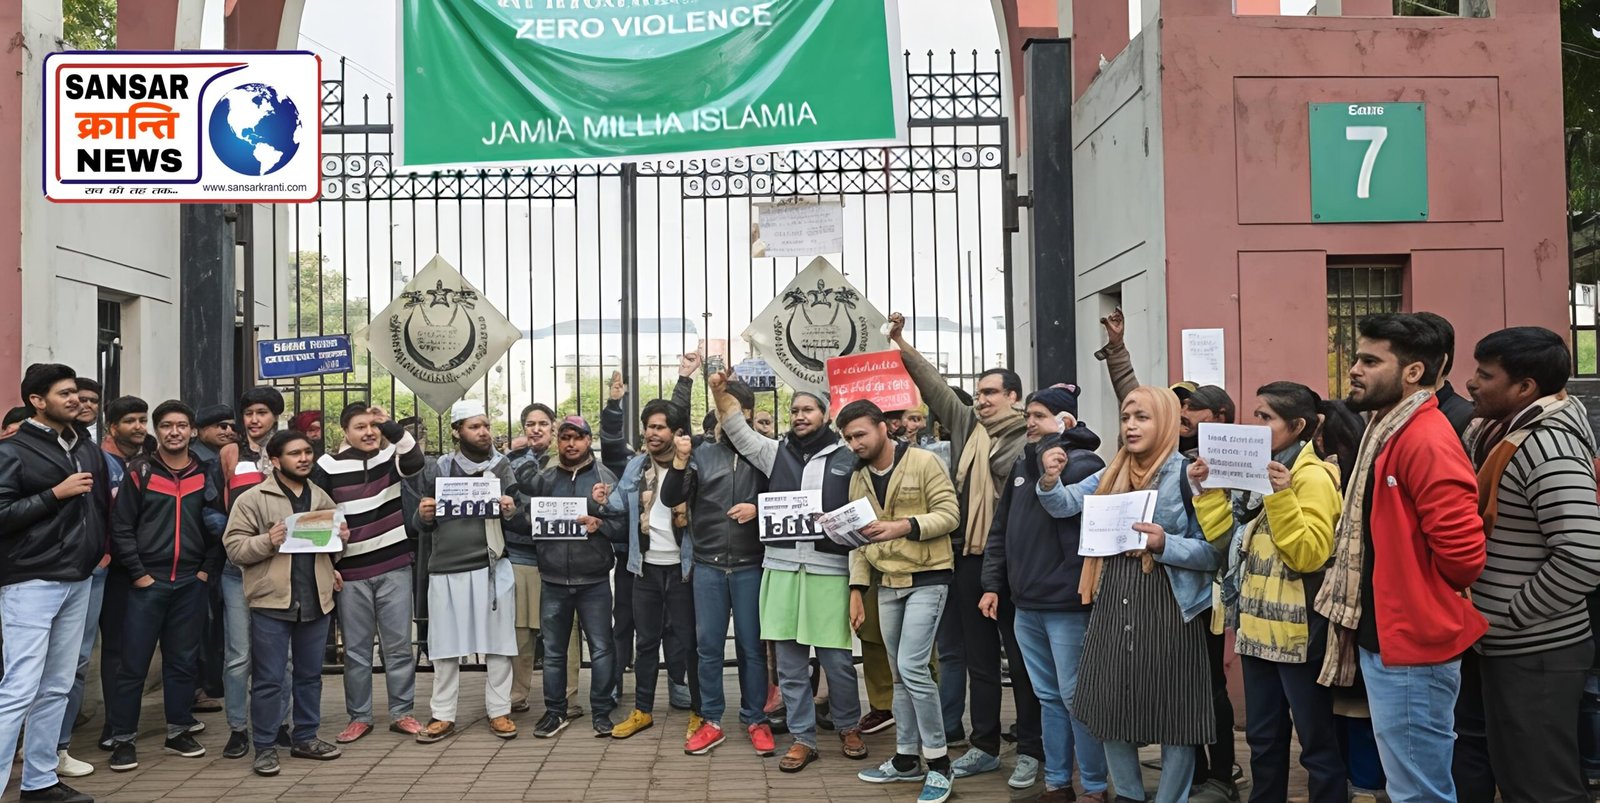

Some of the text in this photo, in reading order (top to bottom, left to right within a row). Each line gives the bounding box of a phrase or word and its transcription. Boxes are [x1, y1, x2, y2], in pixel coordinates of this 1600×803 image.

[515, 2, 773, 39] ZERO VIOLENCE
[481, 100, 818, 146] JAMIA MILLIA ISLAMIA
[1345, 125, 1388, 199] 7
